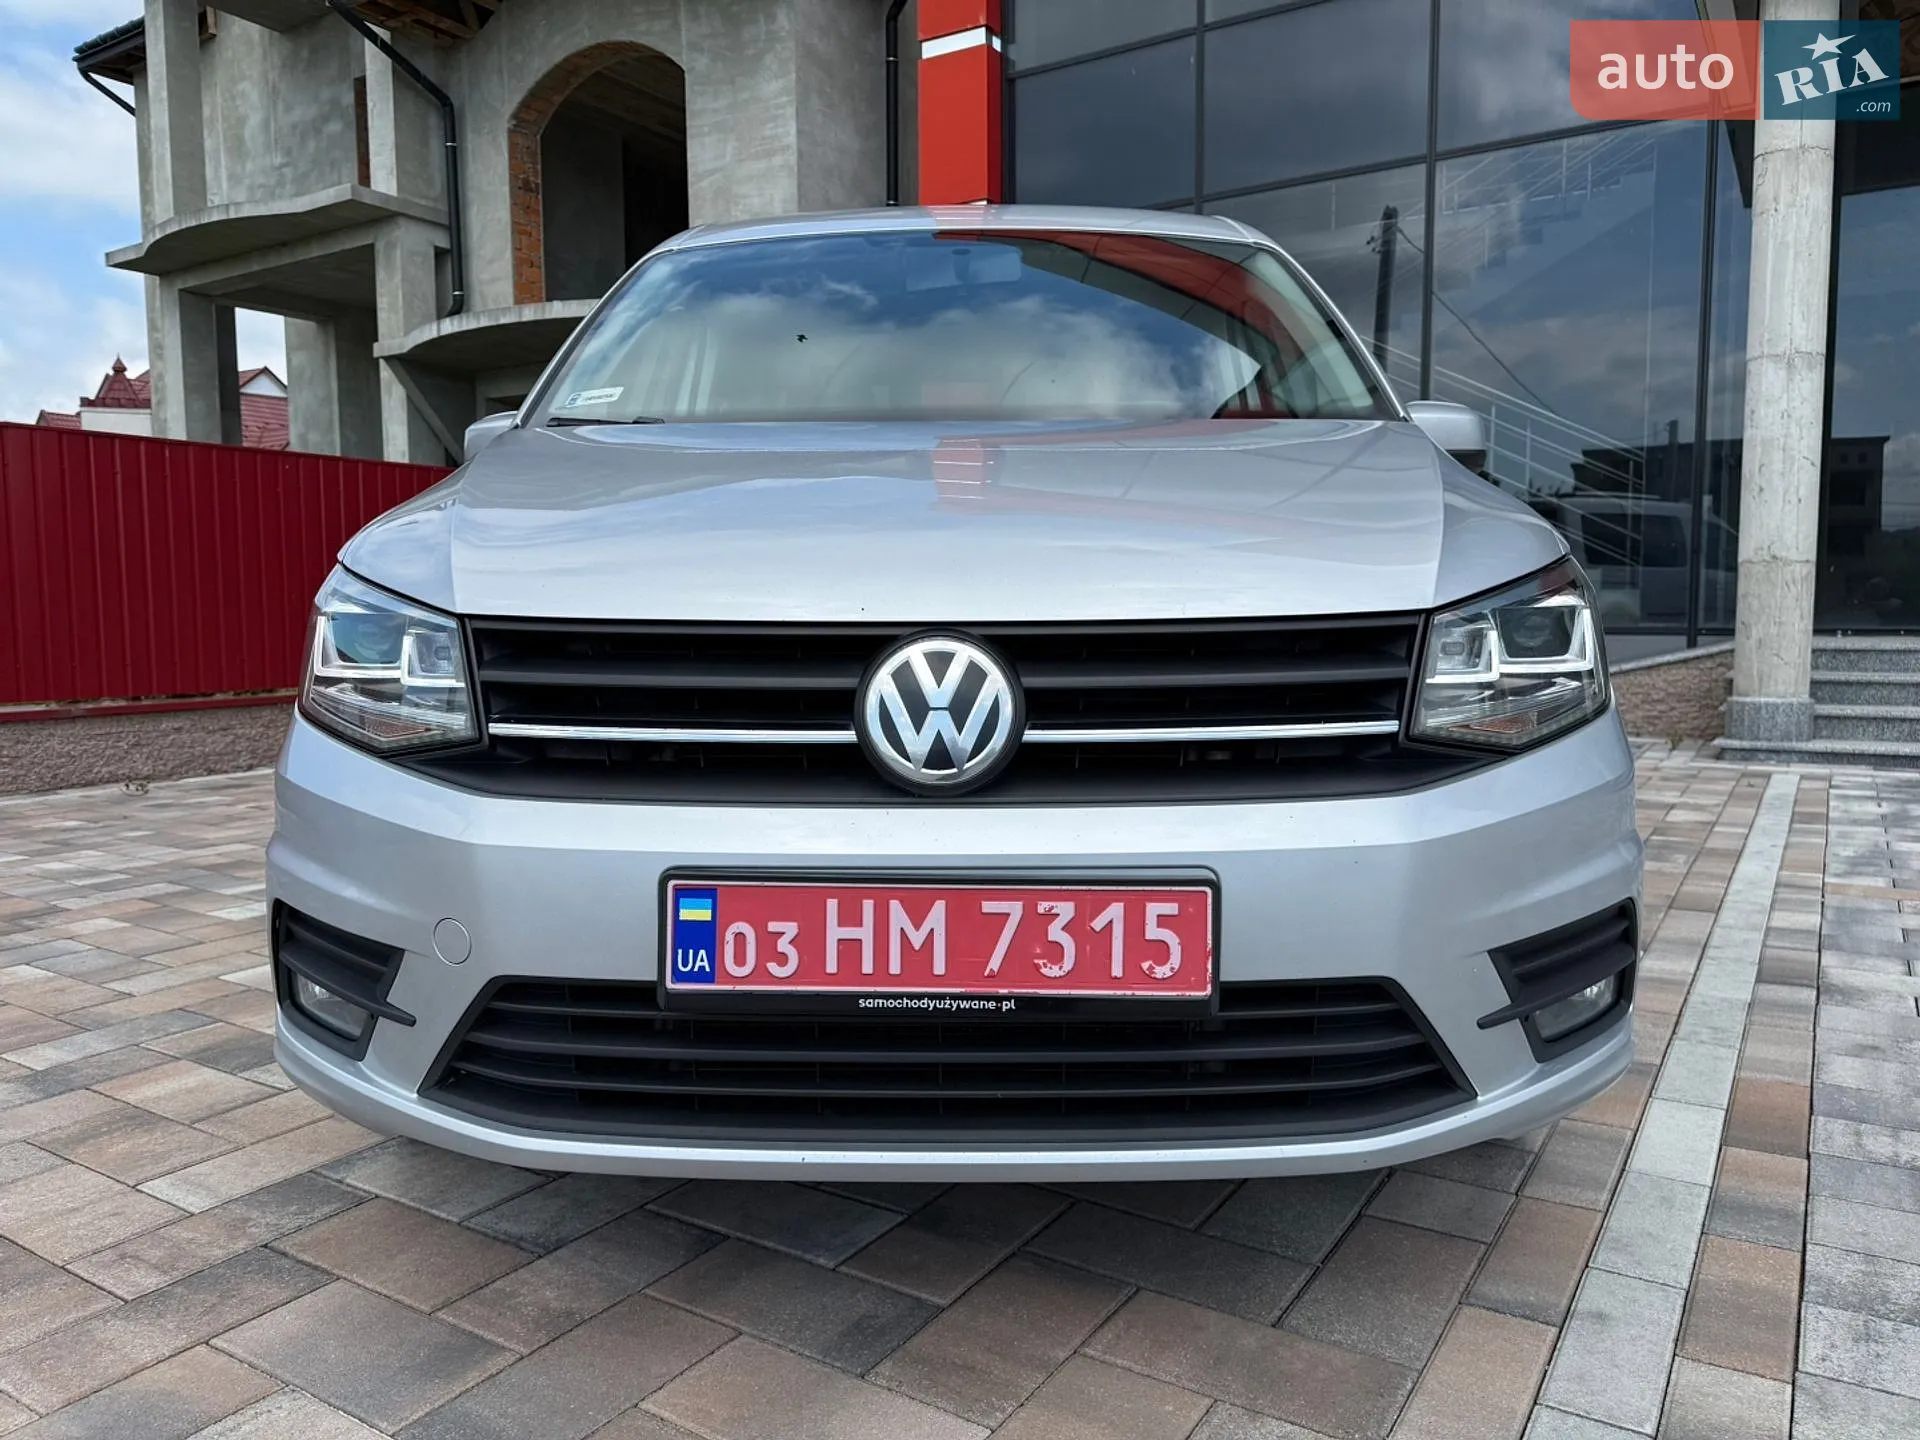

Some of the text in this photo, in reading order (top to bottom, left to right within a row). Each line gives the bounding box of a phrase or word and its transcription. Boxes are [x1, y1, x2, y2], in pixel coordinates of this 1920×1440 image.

[868, 642, 1011, 781] VW
[677, 949, 711, 972] UA
[724, 898, 1182, 979] 03 HM 7315
